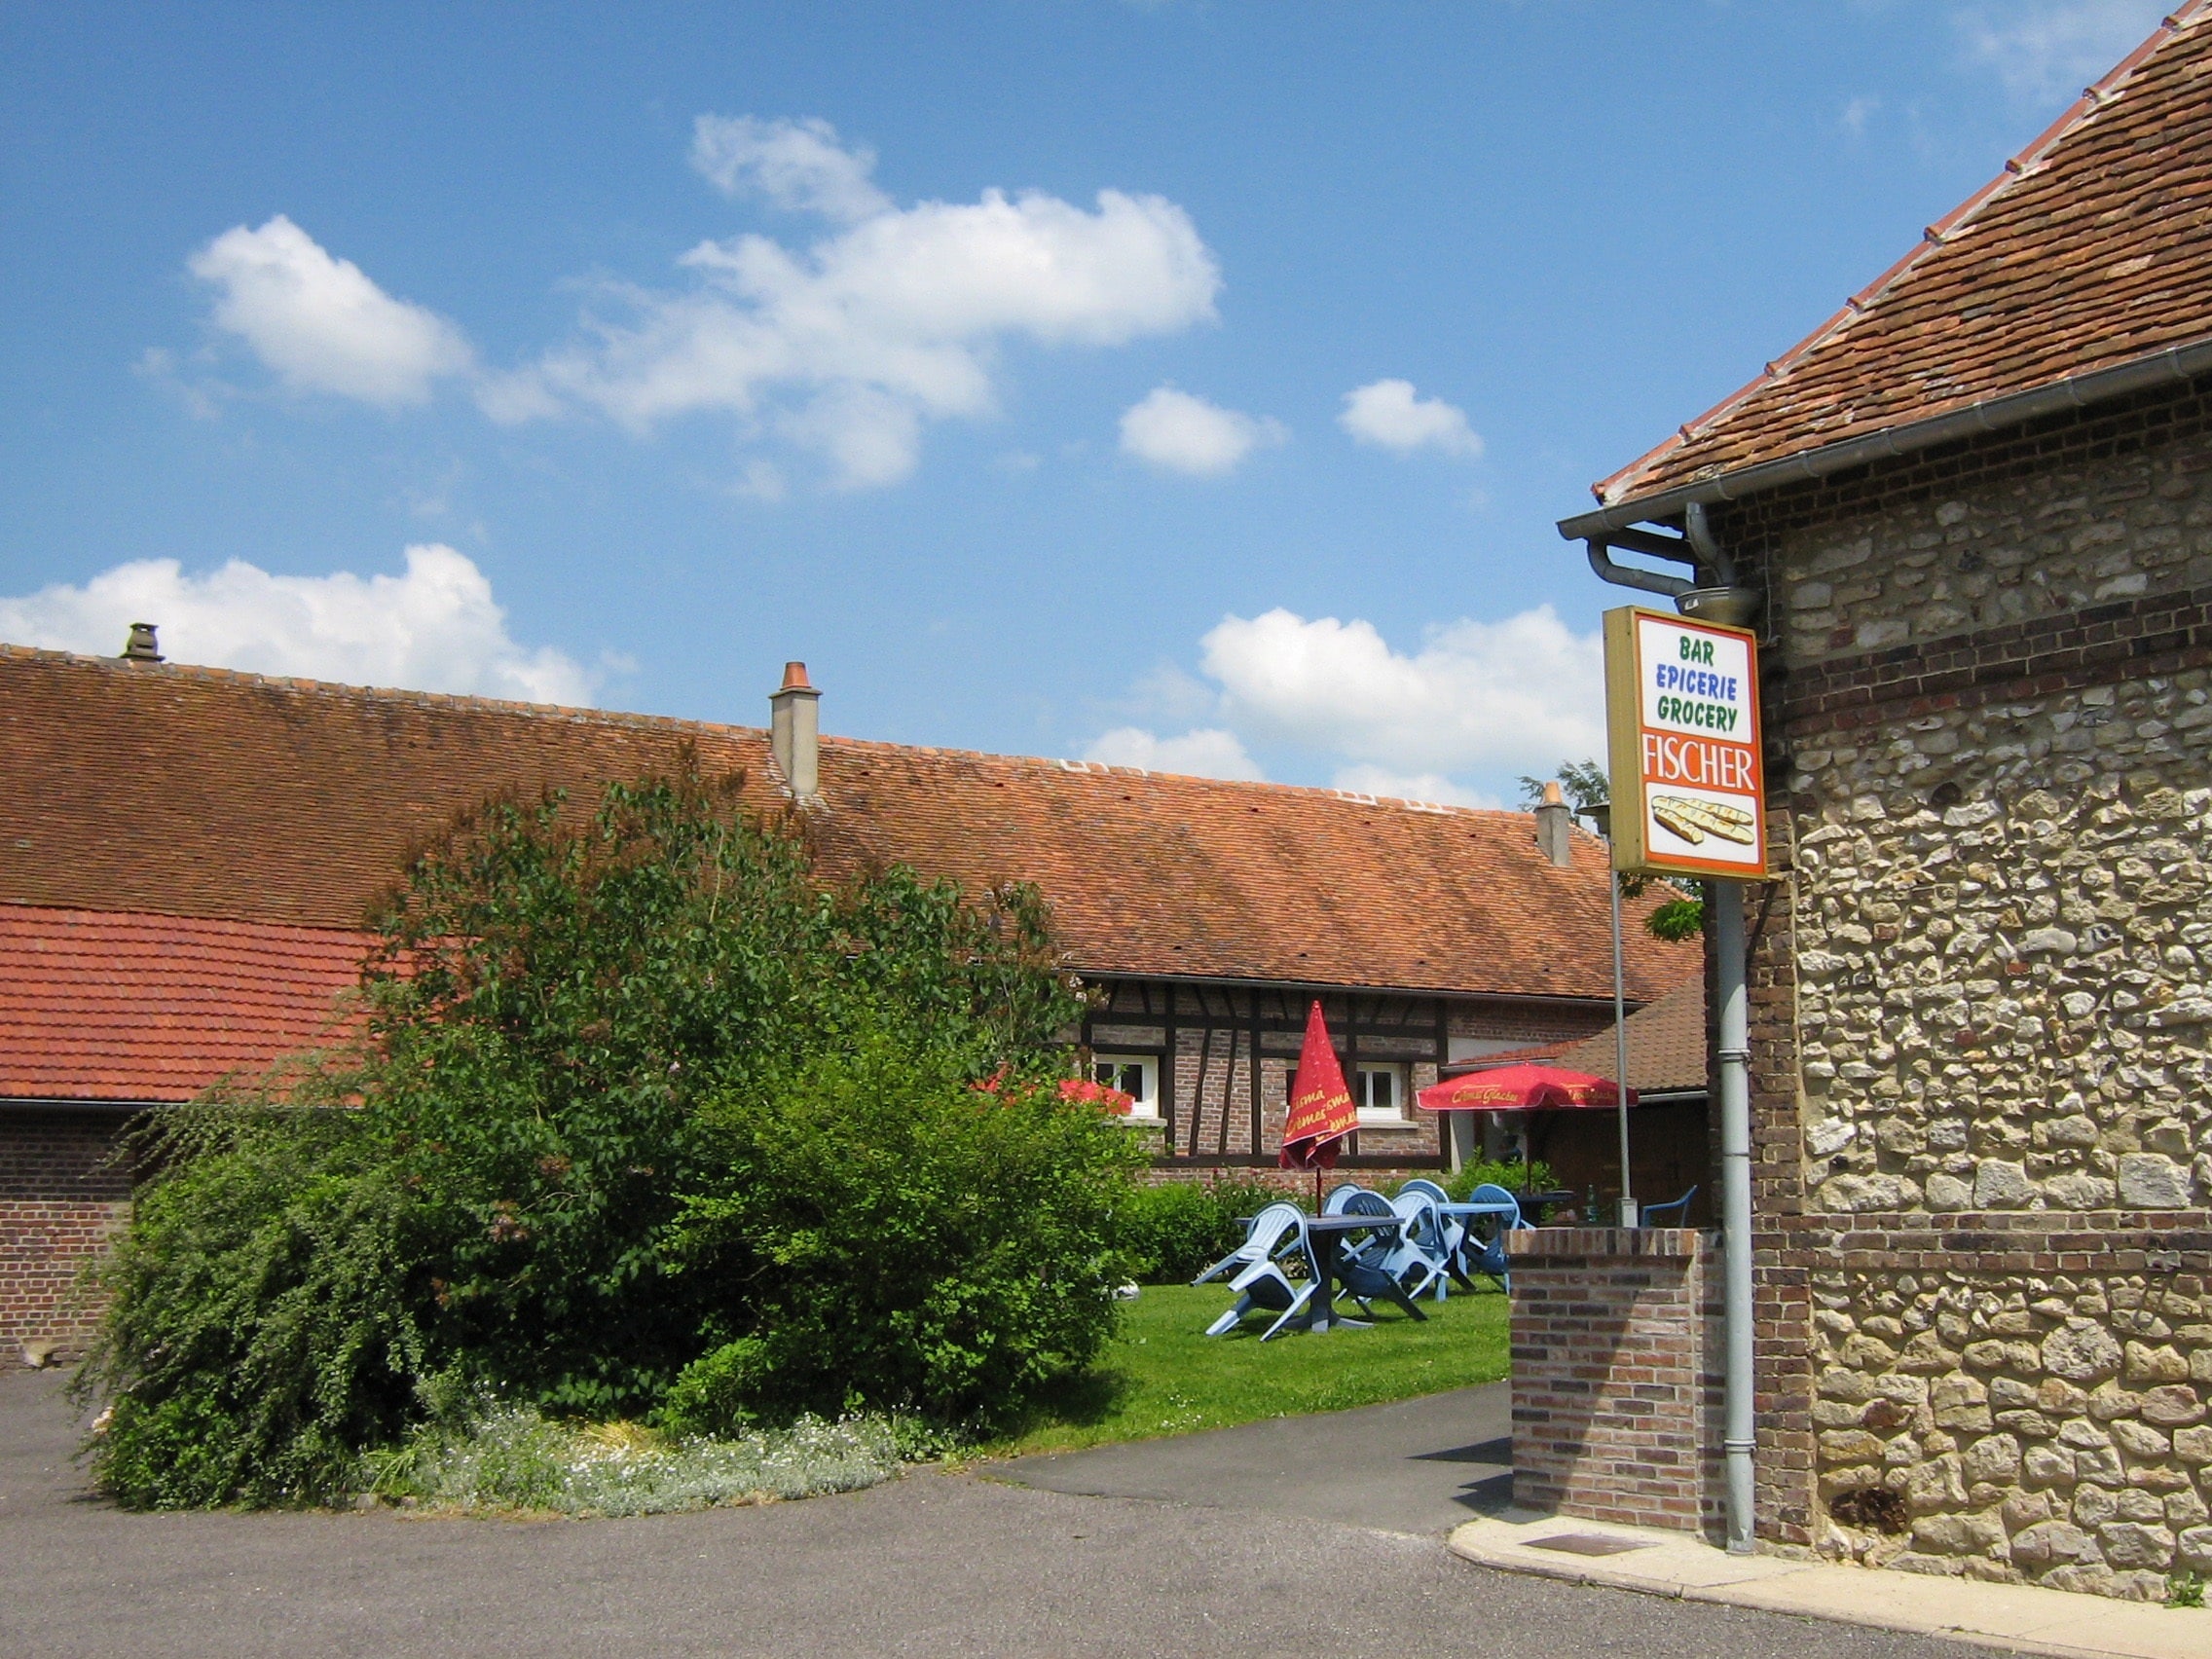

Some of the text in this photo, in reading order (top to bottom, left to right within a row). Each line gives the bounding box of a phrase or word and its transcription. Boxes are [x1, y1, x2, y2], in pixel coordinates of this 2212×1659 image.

[1679, 636, 1714, 667] BAR
[1656, 664, 1737, 701] EPICERIE
[1657, 696, 1738, 732] GROCERY
[1641, 732, 1755, 791] FISCHER
